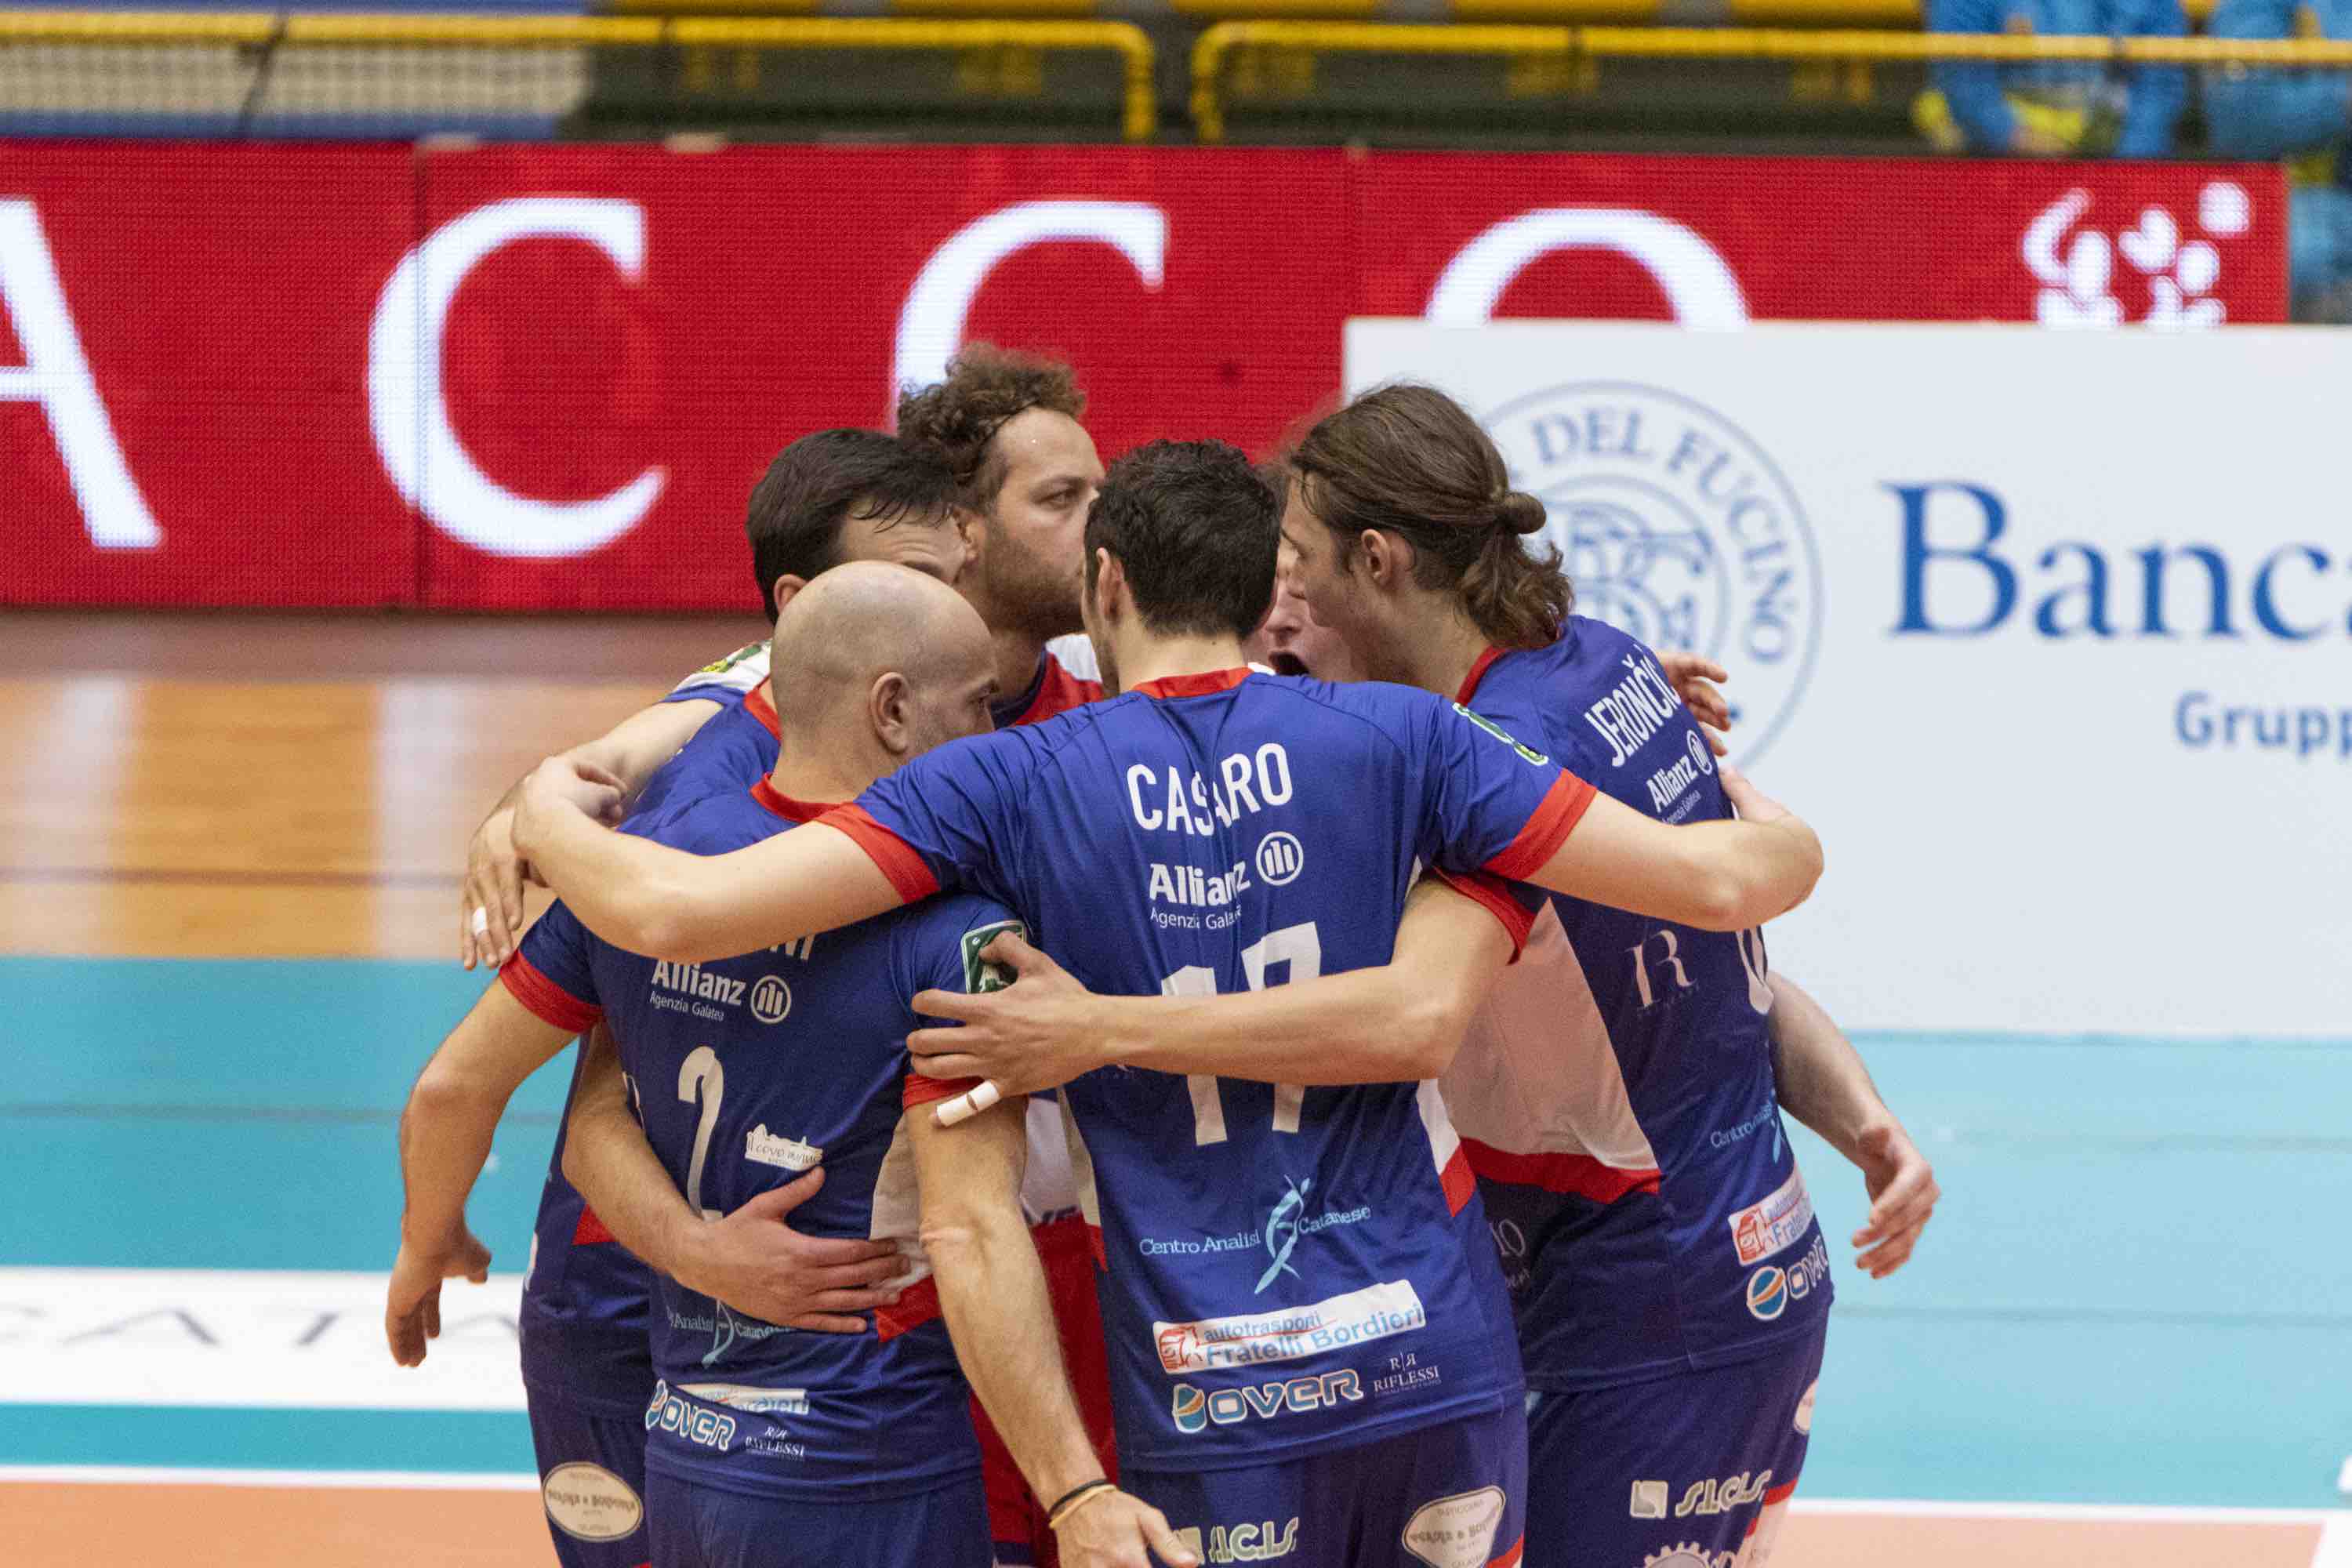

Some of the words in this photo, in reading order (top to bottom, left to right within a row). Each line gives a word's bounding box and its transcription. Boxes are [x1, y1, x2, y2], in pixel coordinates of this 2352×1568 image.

[1530, 406, 1661, 466] DEL
[1664, 428, 1803, 665] FUCINO
[1879, 477, 2352, 644] Banc
[1646, 754, 1699, 814] Allianz
[1149, 860, 1251, 907] Allianz
[651, 958, 747, 1006] Allianz
[1139, 1238, 1200, 1255] Centro
[1206, 1334, 1305, 1367] Fratelli
[1308, 1302, 1423, 1350] Bordieri
[1208, 1368, 1363, 1425] OVER
[1373, 1365, 1439, 1393] RIFLESSI
